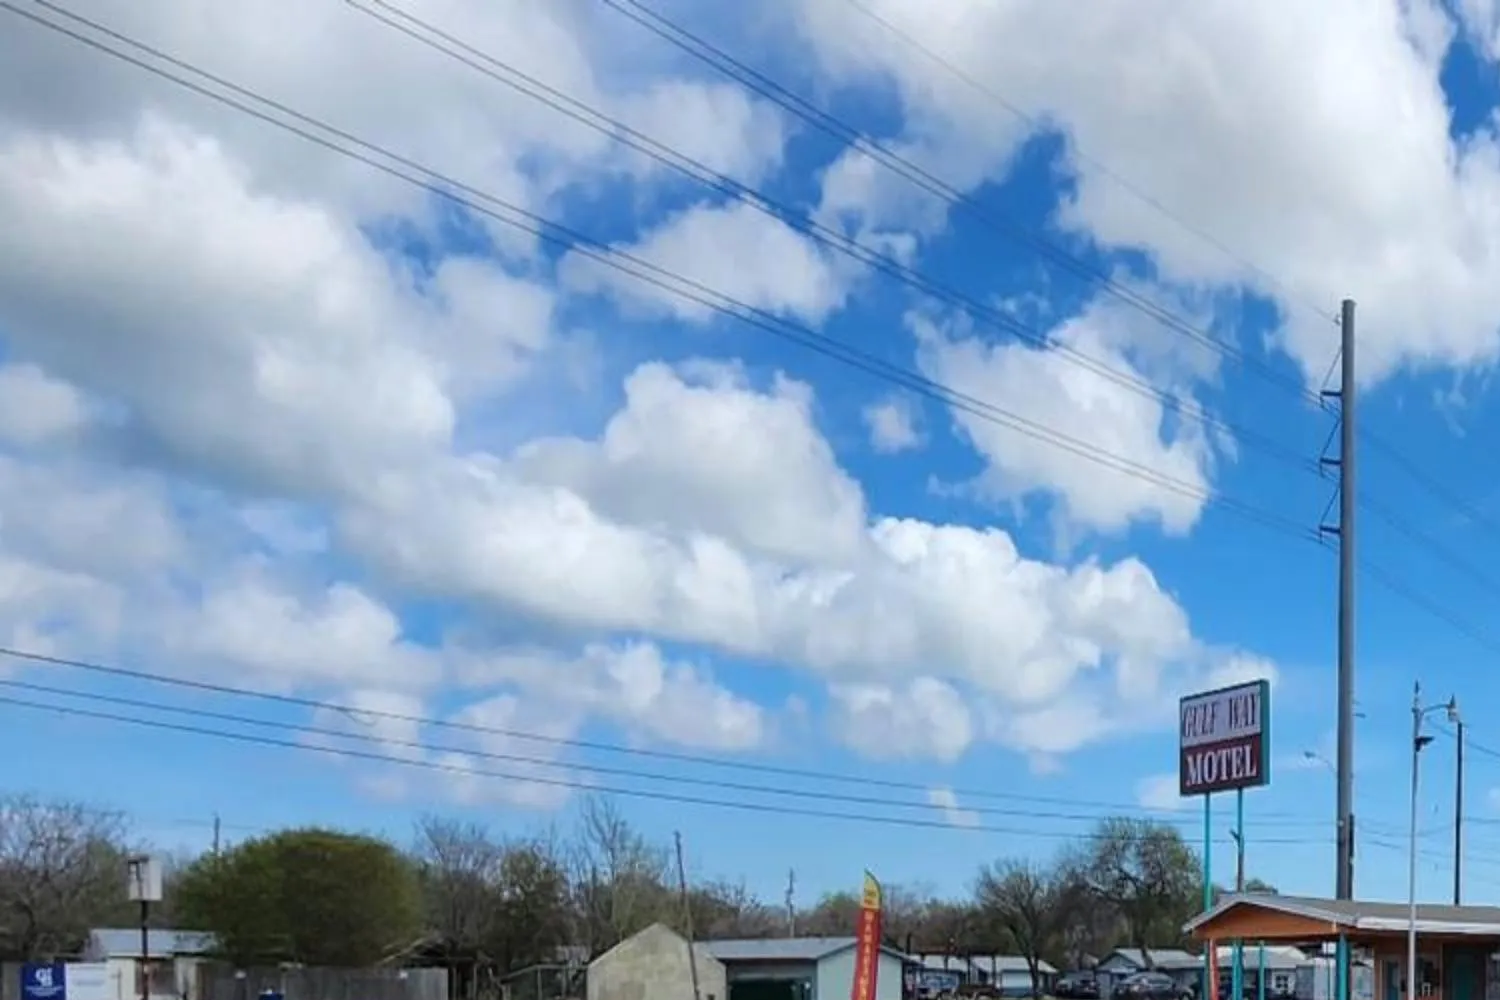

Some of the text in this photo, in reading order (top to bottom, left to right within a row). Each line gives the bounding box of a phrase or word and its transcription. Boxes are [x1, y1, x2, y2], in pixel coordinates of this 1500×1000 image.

[1183, 693, 1258, 737] GULF WAY
[1185, 744, 1257, 787] MOTEL
